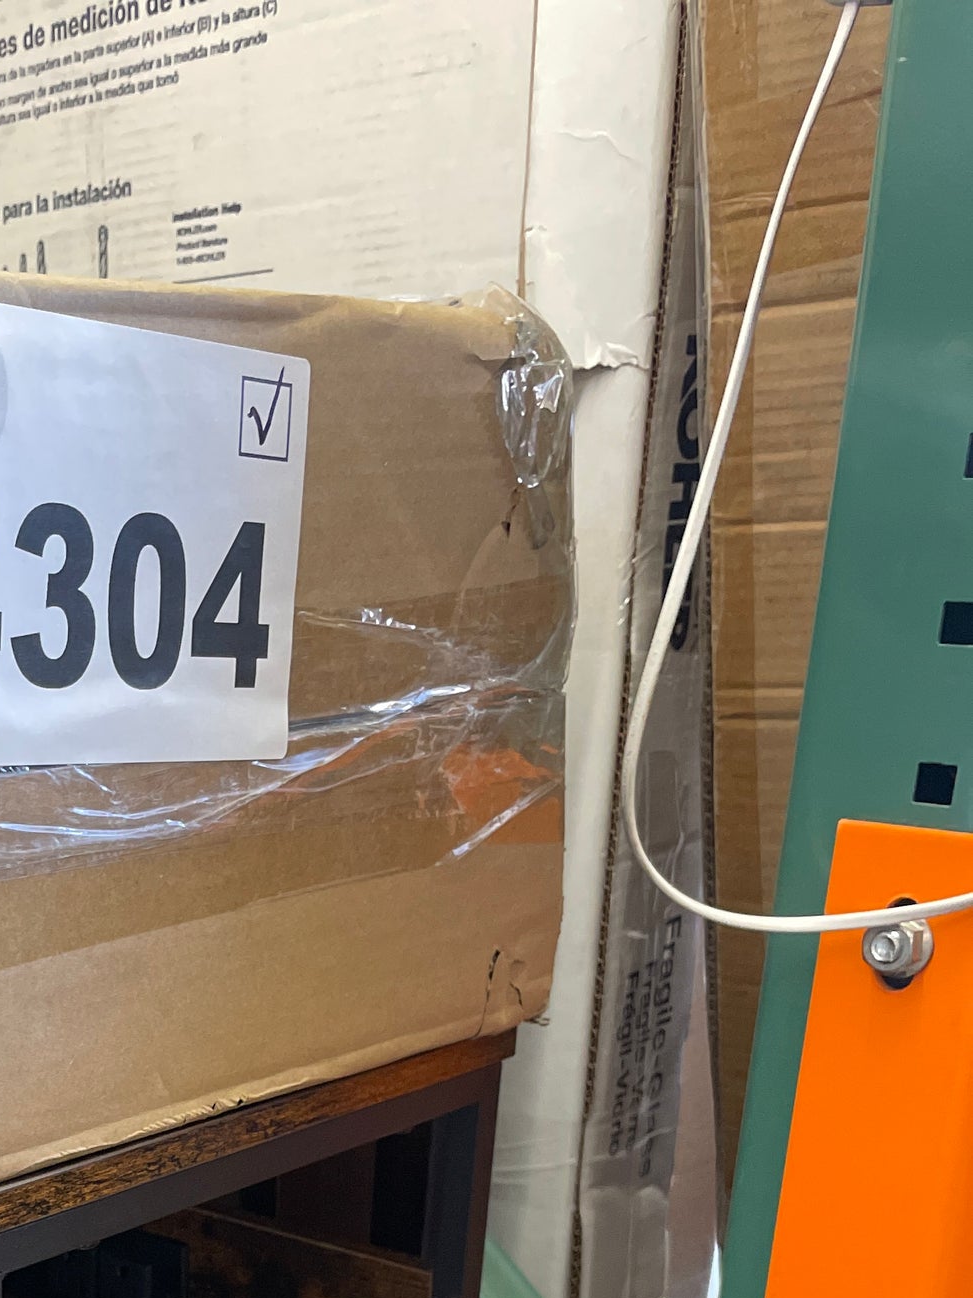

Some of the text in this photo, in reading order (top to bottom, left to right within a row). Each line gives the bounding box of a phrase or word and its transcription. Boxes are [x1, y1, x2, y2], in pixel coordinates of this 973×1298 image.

[23, 24, 45, 51] de
[51, 0, 139, 43] medición
[2, 200, 33, 225] para
[36, 194, 48, 214] la
[52, 178, 132, 211] instalación
